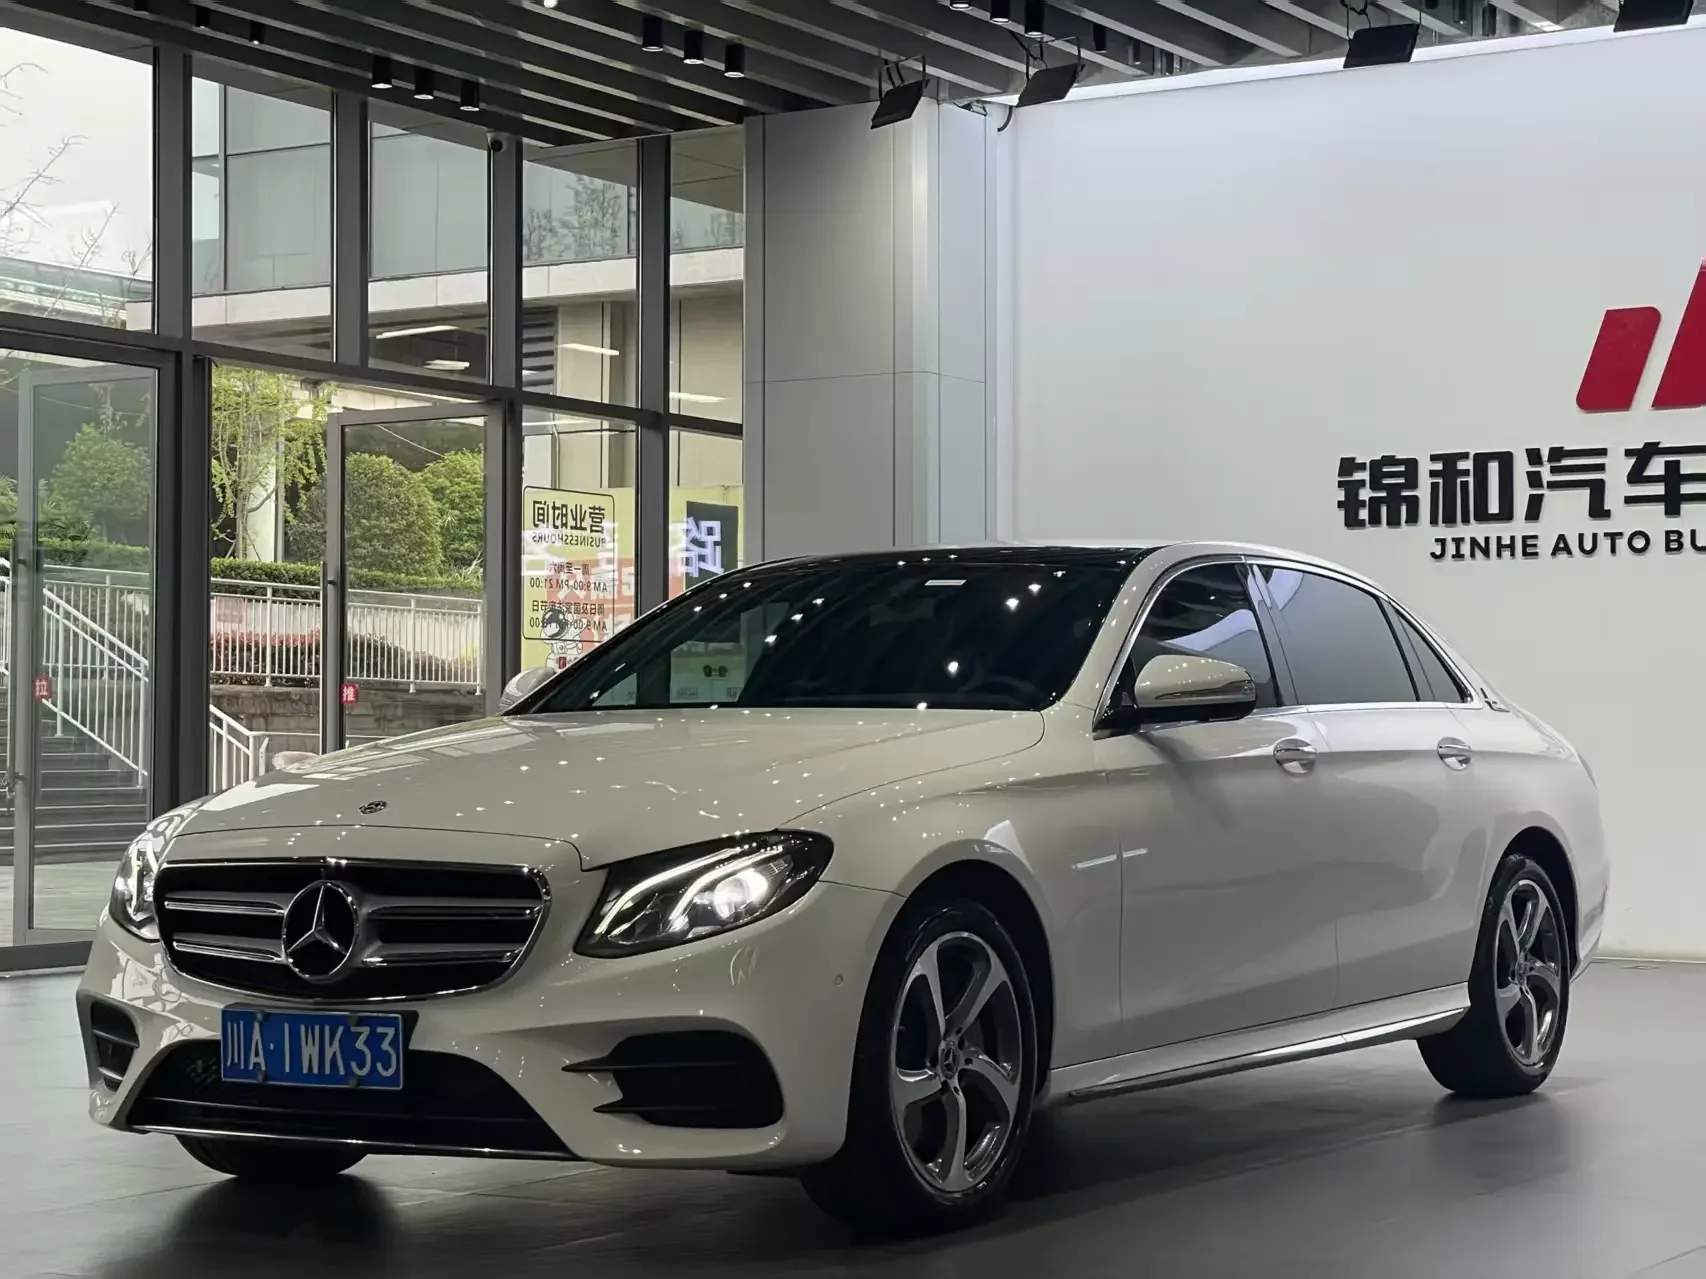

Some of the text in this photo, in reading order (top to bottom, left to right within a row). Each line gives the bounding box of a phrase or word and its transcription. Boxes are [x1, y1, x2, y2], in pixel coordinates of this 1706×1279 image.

[1337, 440, 1706, 529] 锦和汽车
[1429, 528, 1706, 561] JINHE AUTO BU
